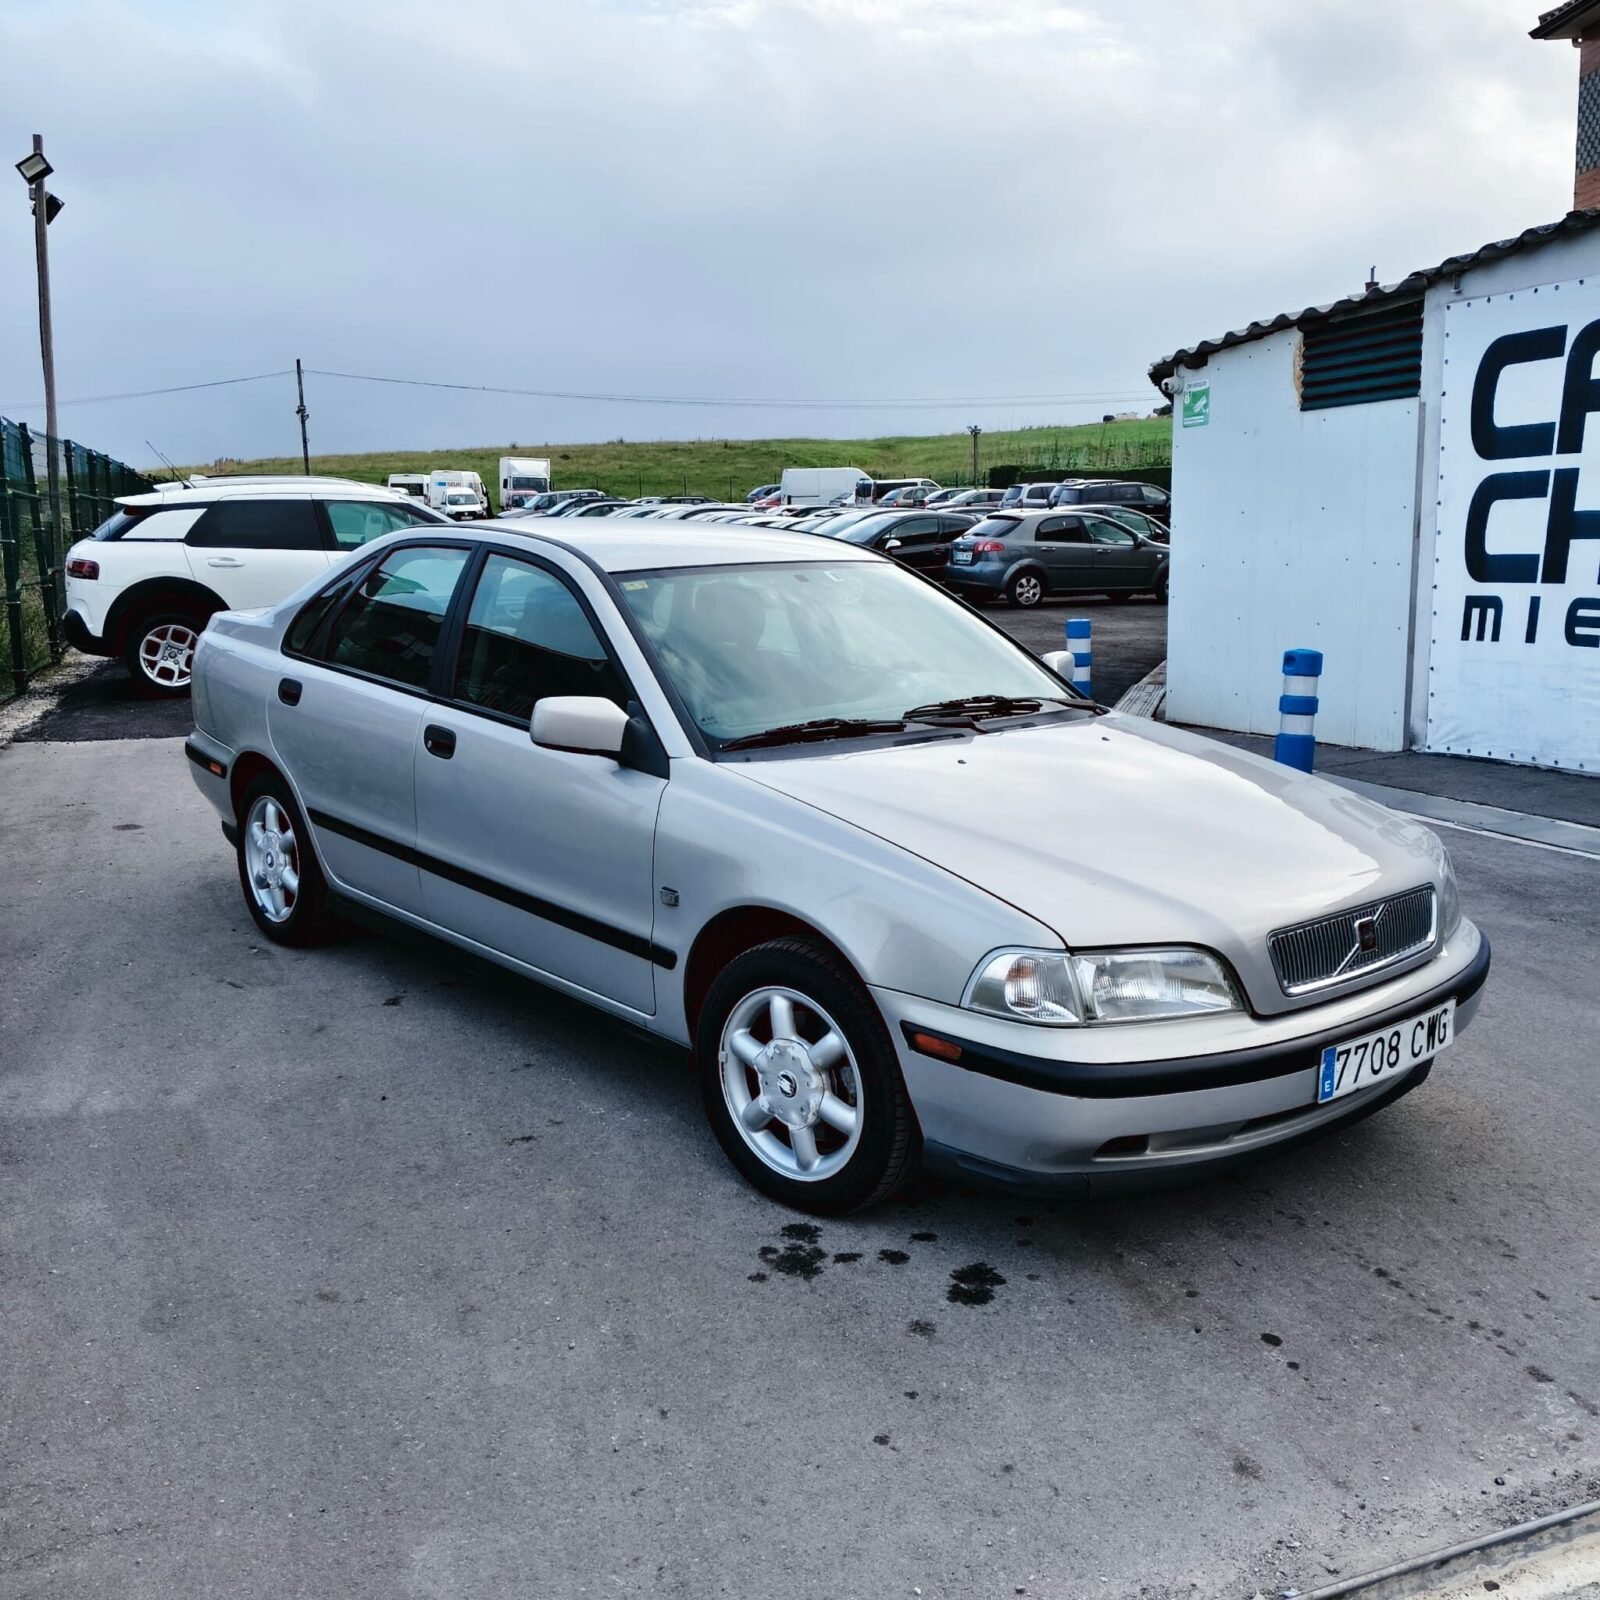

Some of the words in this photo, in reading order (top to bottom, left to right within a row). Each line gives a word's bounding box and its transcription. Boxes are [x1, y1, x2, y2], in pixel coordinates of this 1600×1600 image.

[1335, 1030, 1401, 1091] 7708
[1411, 1008, 1449, 1059] CWG
[1324, 1080, 1331, 1092] E
